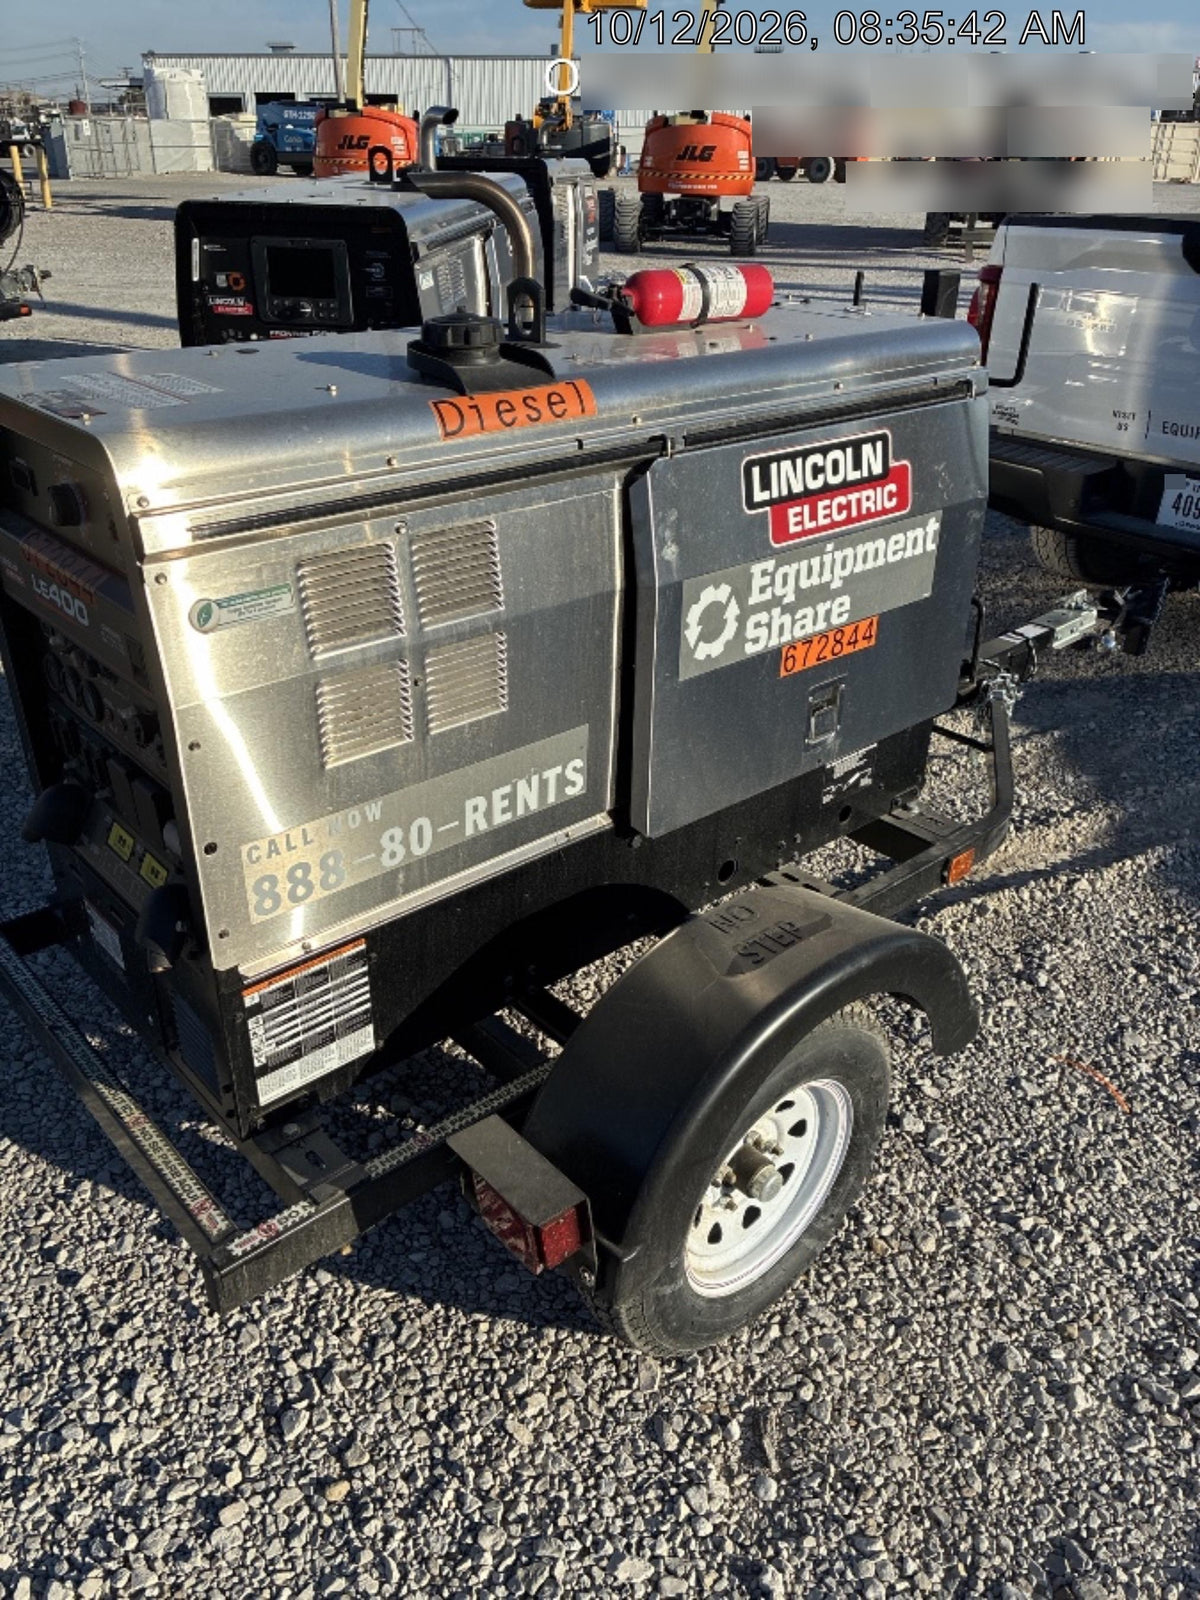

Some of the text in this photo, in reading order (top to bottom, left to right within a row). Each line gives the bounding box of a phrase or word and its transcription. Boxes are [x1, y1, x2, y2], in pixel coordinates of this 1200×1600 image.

[337, 134, 371, 150] JLG
[676, 145, 717, 161] JLG
[432, 381, 585, 437] Diesel
[1112, 410, 1137, 421] VISIT
[751, 440, 884, 504] LINCOLN
[787, 483, 898, 535] ELECTRIC
[747, 517, 940, 605] Equipment
[743, 593, 851, 656] Share
[782, 619, 876, 673] 672844
[245, 800, 384, 867] CALL NOW
[252, 758, 585, 918] 888-80-RENTS
[708, 905, 760, 935] NO
[733, 920, 802, 965] STEP
